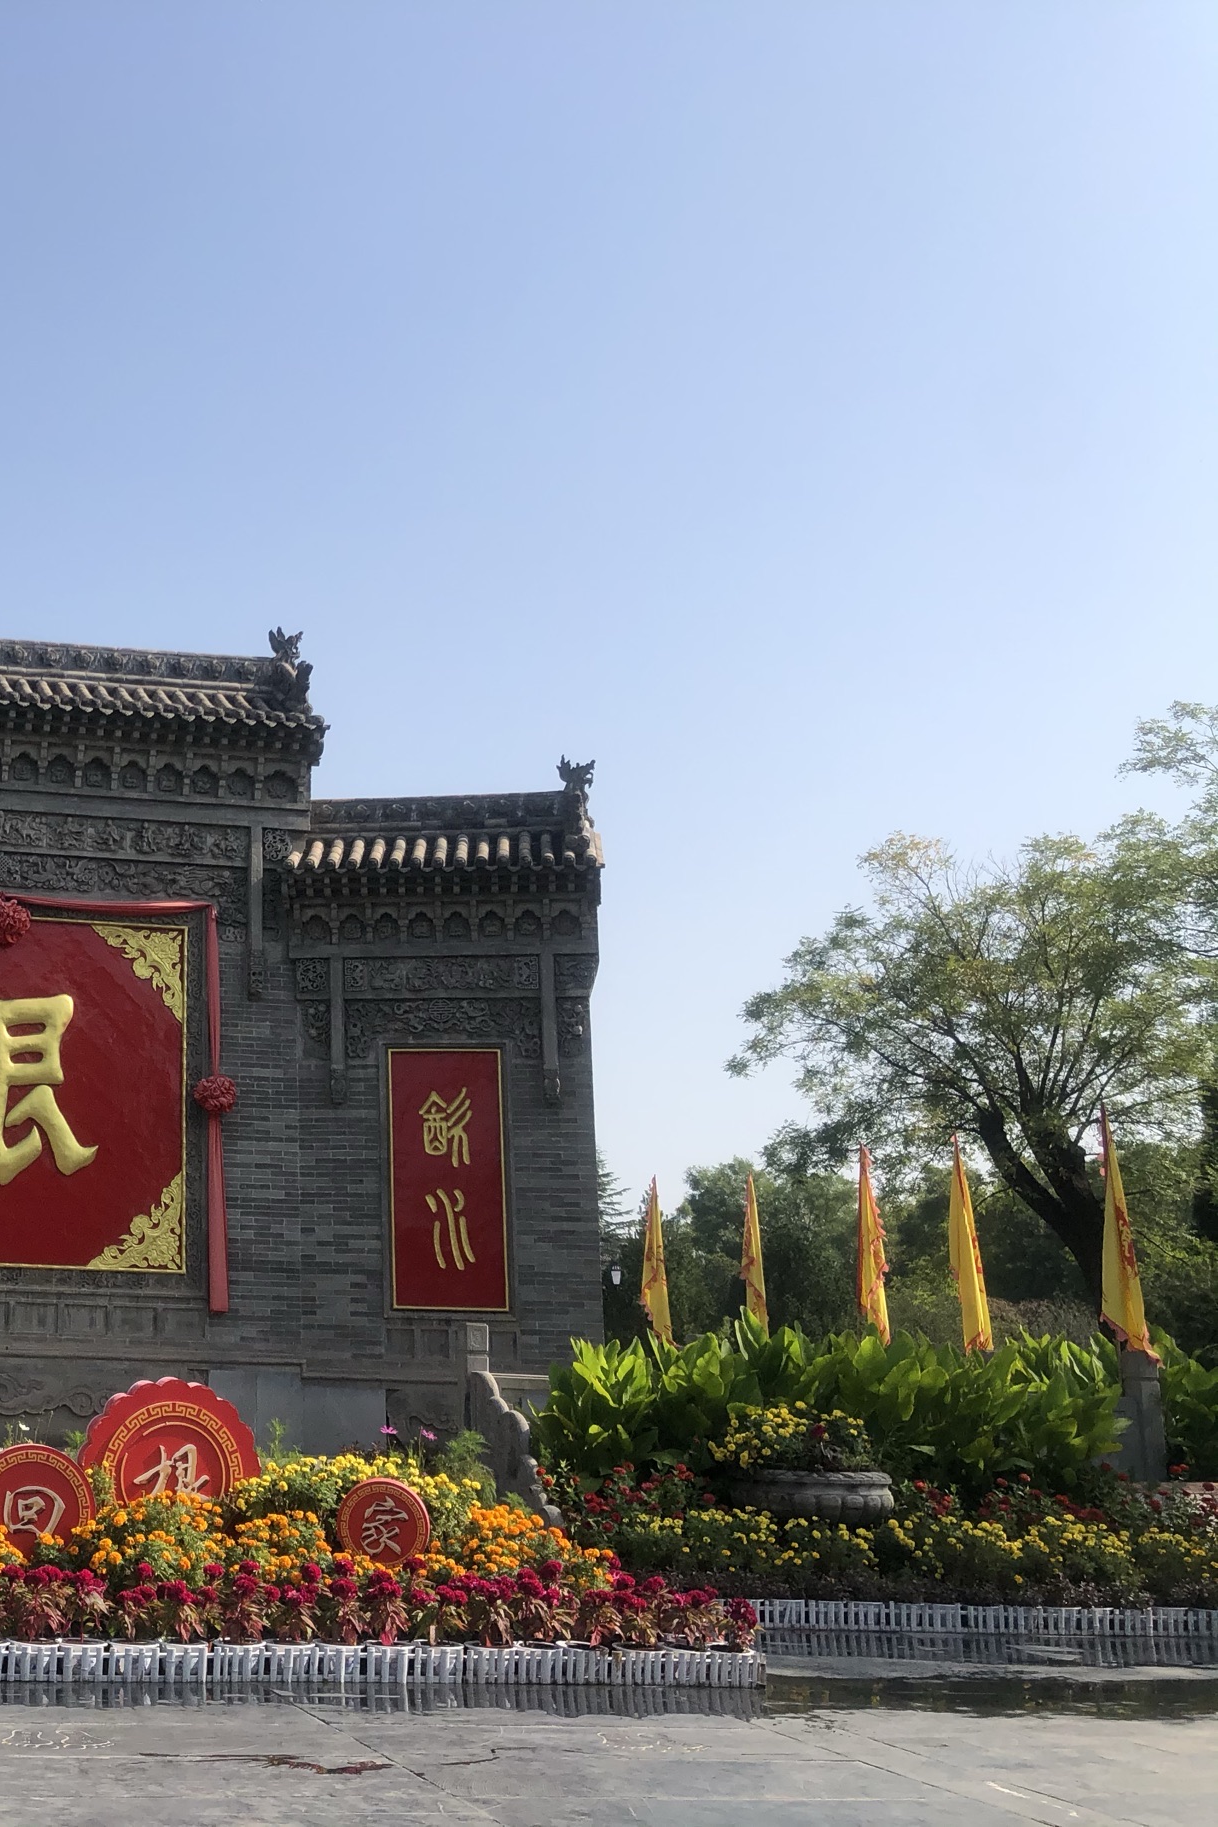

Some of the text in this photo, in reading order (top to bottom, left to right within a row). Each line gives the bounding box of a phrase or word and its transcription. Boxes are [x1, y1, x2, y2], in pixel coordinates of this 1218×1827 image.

[133, 1444, 210, 1502] 根
[3, 1485, 66, 1540] 回
[360, 1495, 409, 1556] 家
